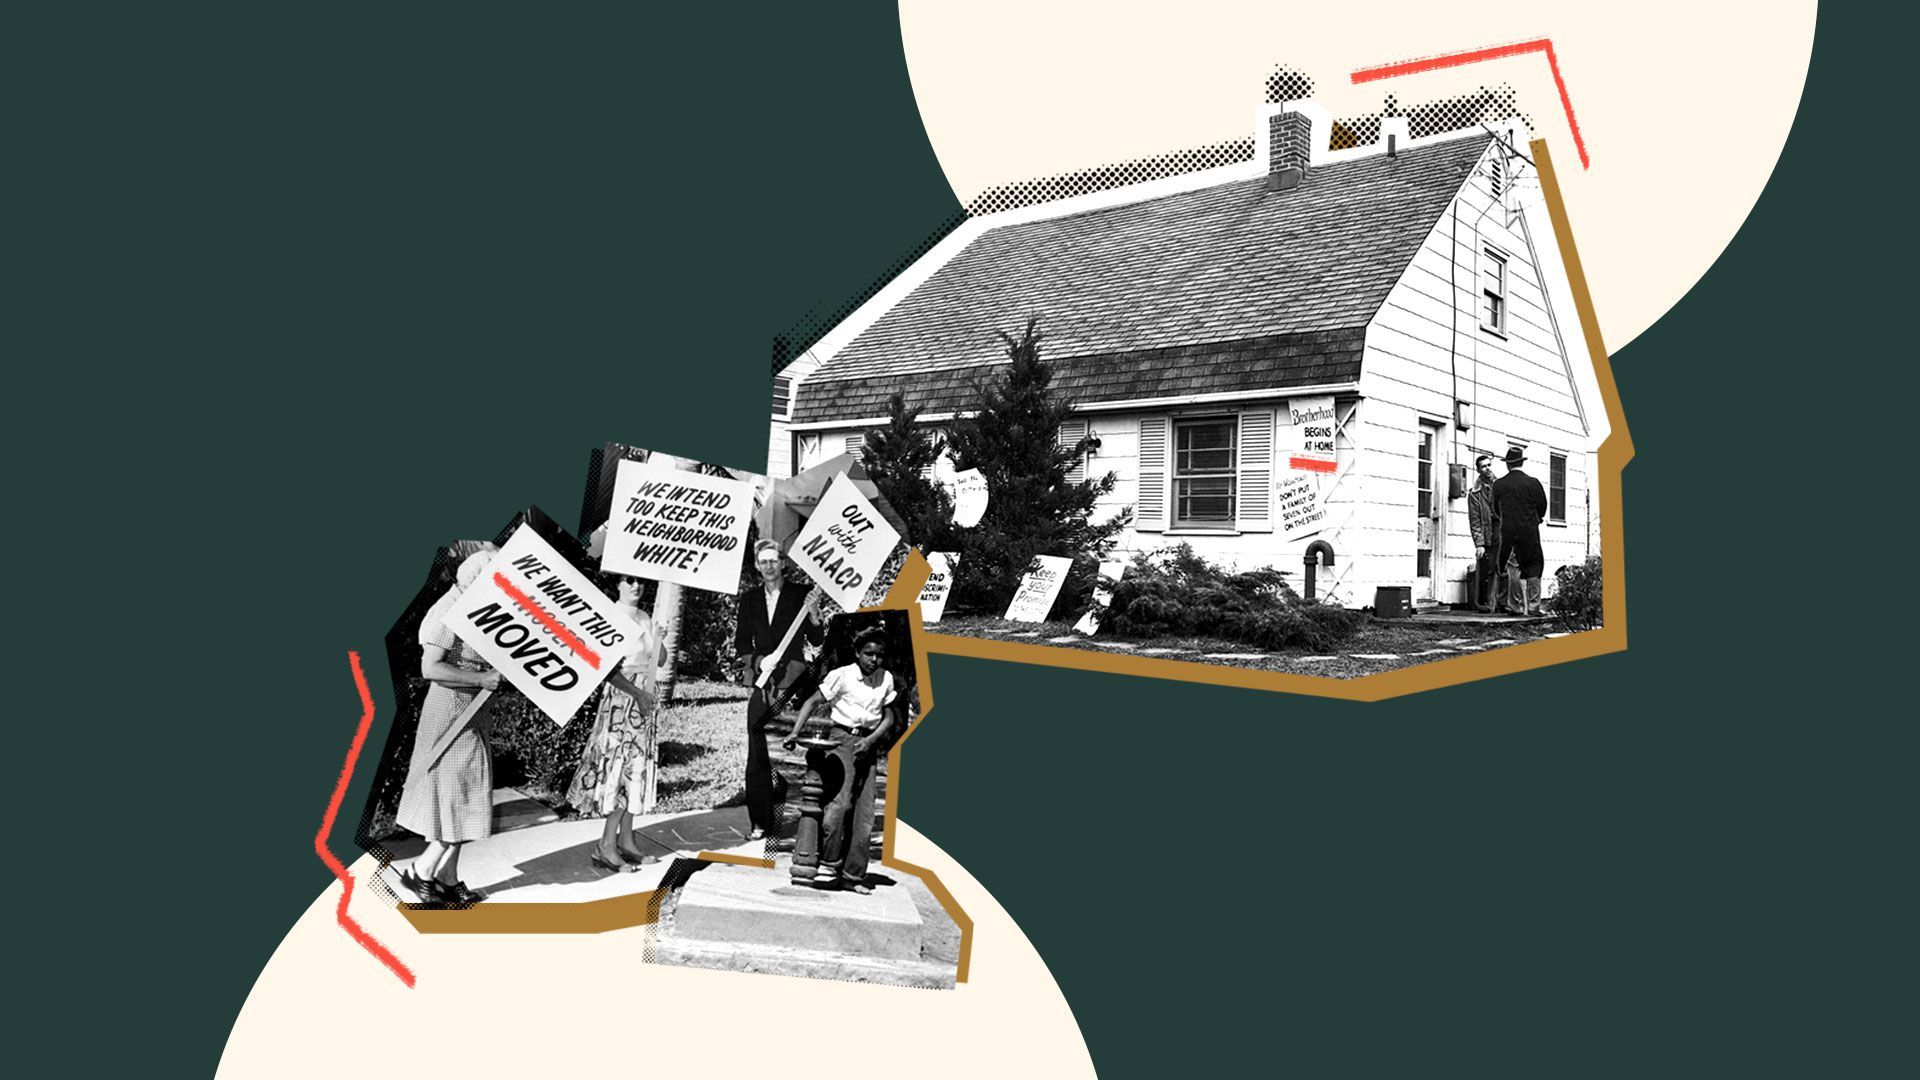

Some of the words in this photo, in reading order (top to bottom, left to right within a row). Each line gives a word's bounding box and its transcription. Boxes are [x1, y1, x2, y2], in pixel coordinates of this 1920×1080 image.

[1304, 427, 1332, 438] BEGINS
[1304, 441, 1313, 451] AT
[1314, 441, 1334, 451] HOME
[637, 480, 671, 498] WE
[665, 485, 731, 510] INTEND
[1287, 496, 1307, 509] FAMILY
[1308, 492, 1316, 501] OF
[1298, 484, 1310, 494] PUT
[625, 497, 656, 517] TOO
[654, 503, 699, 523] KEEP
[698, 510, 736, 531] THIS
[841, 504, 874, 533] OUT
[1282, 510, 1301, 521] SEVEN
[1303, 503, 1316, 514] OUT
[1284, 523, 1294, 531] ON
[1294, 517, 1306, 528] THE
[623, 517, 738, 552] NEIGHBORHOOD
[828, 524, 863, 554] with
[632, 542, 709, 573] WHITE!
[802, 534, 863, 591] NAACP
[929, 572, 945, 582] END
[511, 553, 551, 580] WE
[536, 575, 593, 616] WANT
[579, 612, 625, 648] THIS
[920, 593, 941, 602] NATION
[467, 602, 579, 692] MOVED
